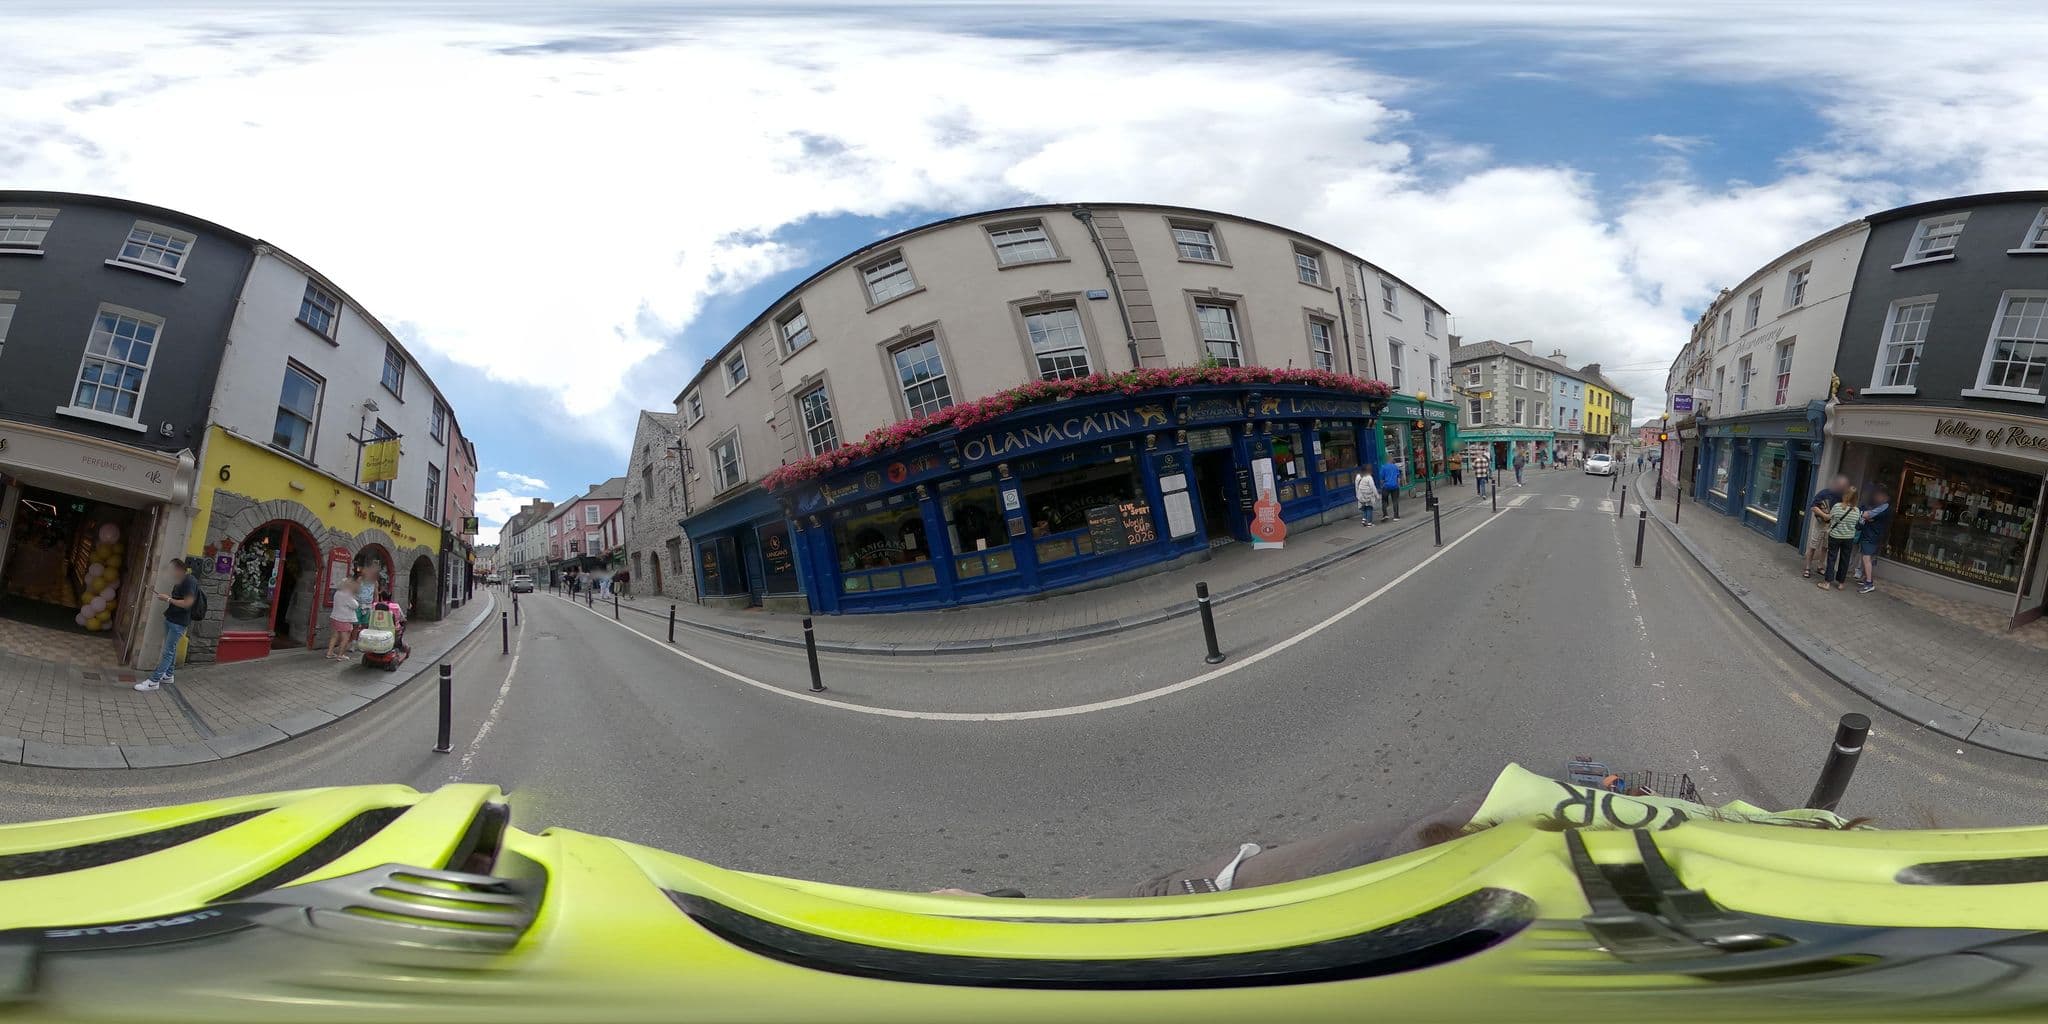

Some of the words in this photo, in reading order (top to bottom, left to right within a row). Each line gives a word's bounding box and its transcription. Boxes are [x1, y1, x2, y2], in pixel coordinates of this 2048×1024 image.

[1934, 418, 1981, 443] Valley
[1985, 426, 2004, 446] of
[82, 455, 127, 472] PERFUMERY
[219, 464, 231, 482] 6
[352, 499, 368, 520] The
[1119, 503, 1135, 512] LIVE
[1127, 530, 1155, 546] 2026
